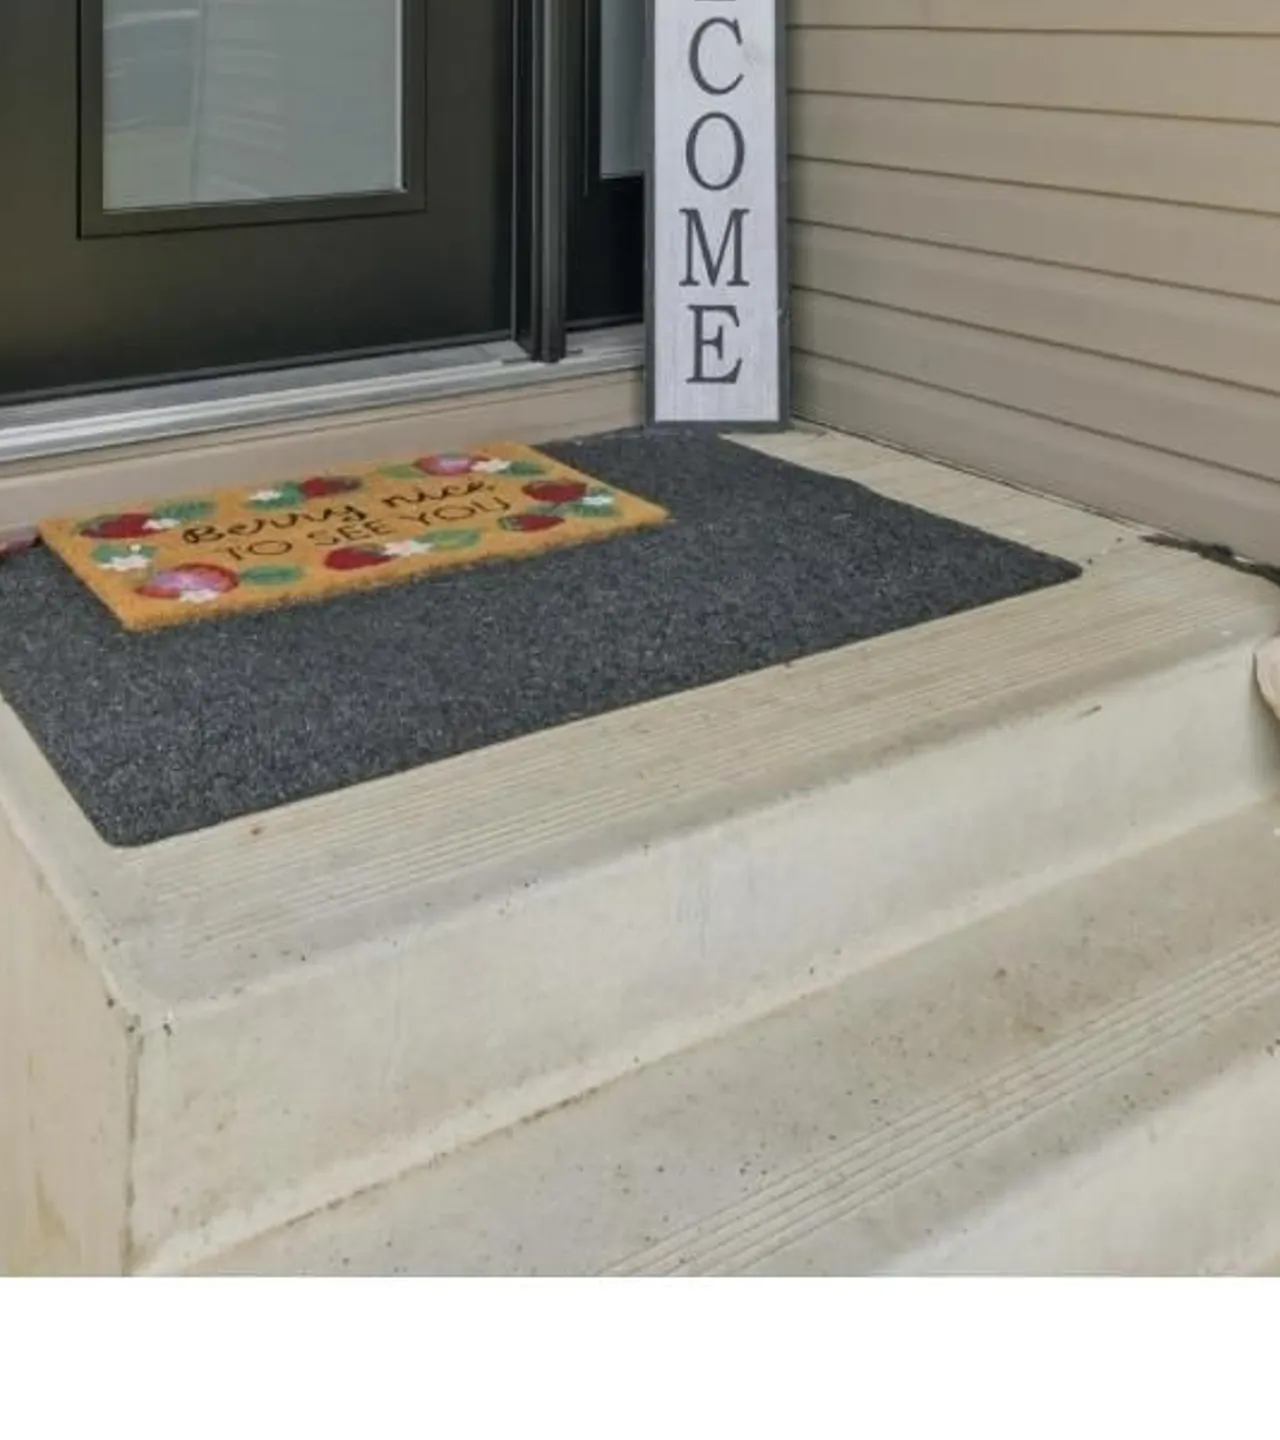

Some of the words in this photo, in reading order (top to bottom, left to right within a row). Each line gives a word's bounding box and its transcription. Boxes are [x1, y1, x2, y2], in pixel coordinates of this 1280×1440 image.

[182, 504, 368, 544] Berry
[381, 480, 494, 508] nice
[222, 539, 293, 561] TO
[306, 518, 395, 546] SEE
[394, 496, 511, 526] YOU
